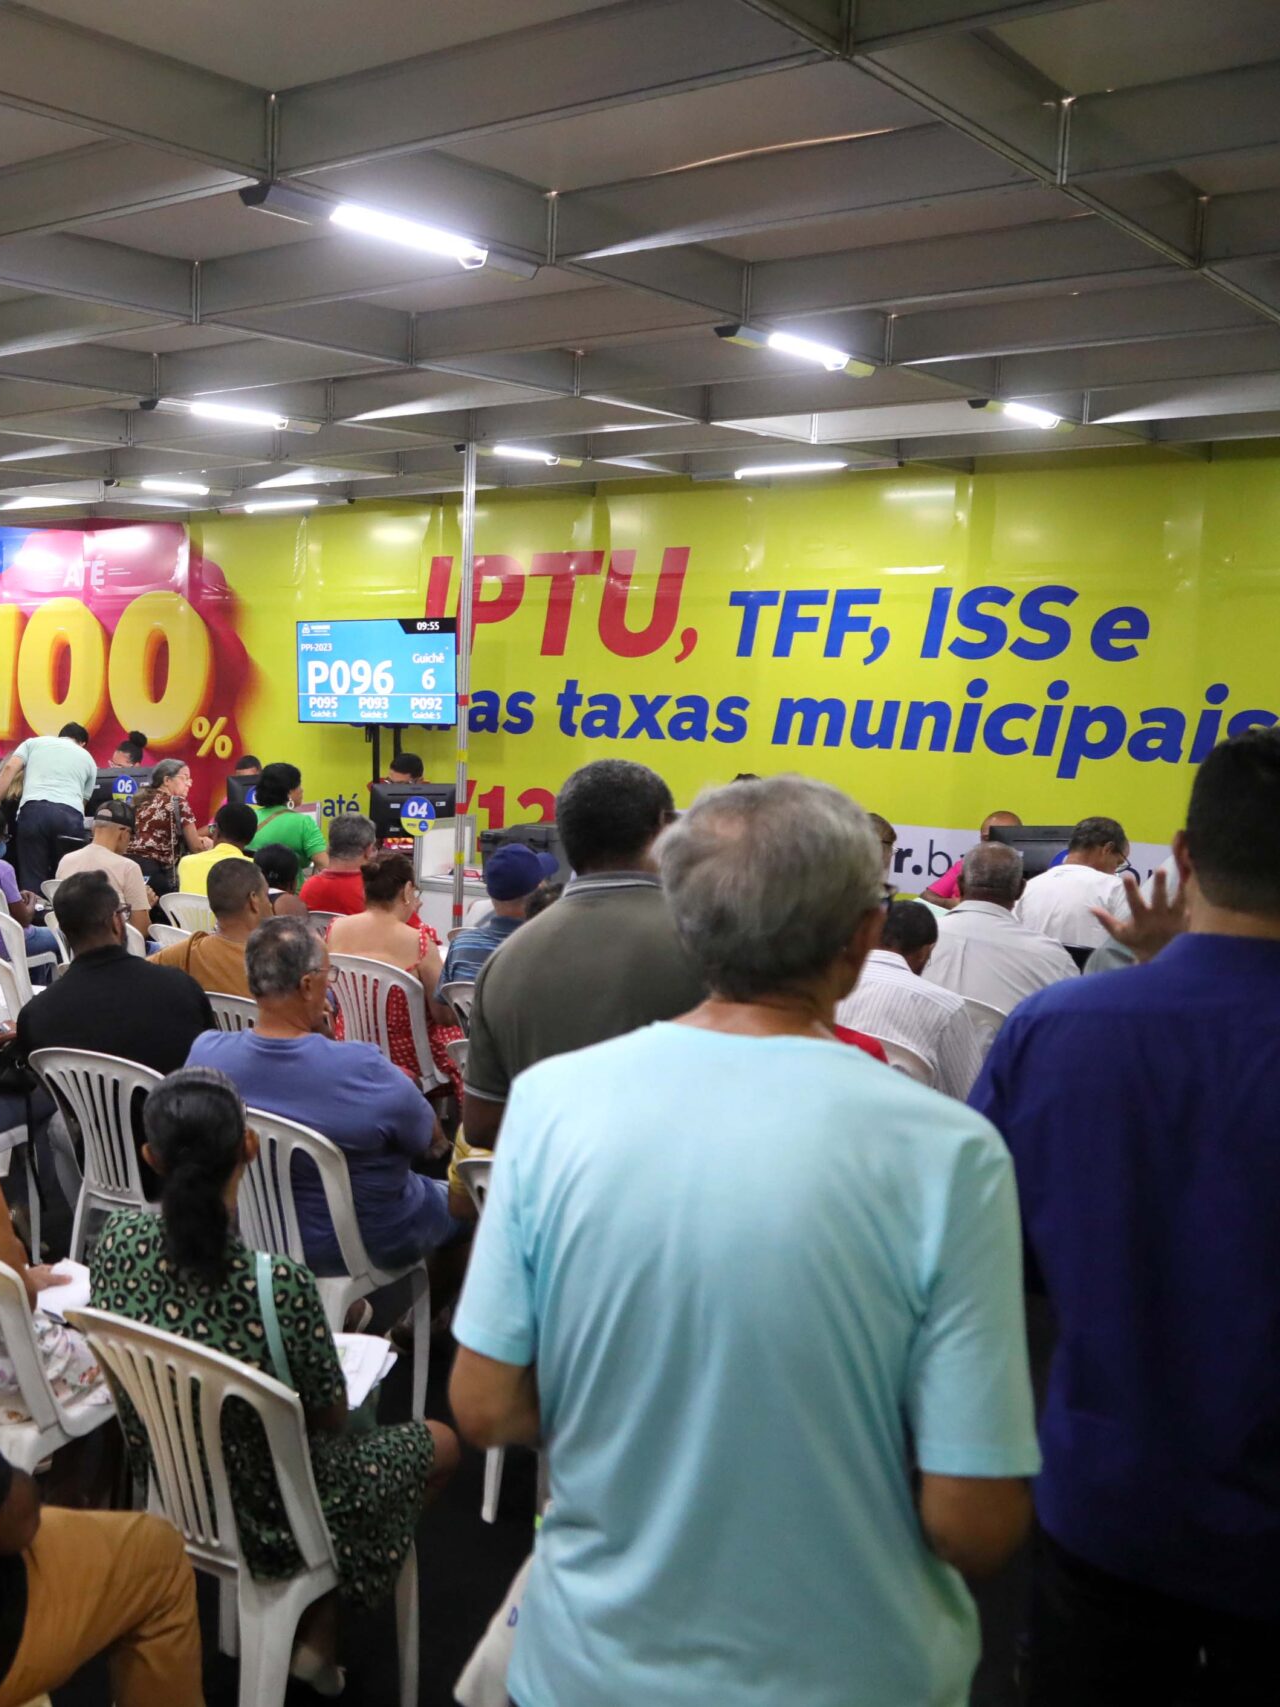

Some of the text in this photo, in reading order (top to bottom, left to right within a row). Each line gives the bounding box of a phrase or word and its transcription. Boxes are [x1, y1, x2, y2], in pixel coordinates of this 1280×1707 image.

[63, 554, 107, 587] ATÉ
[424, 546, 1149, 667] IPTU, TFF, ISS e
[417, 621, 439, 631] 09:55
[412, 653, 445, 664] Guichê
[308, 660, 394, 694] P096
[422, 668, 436, 690] 6
[309, 697, 338, 709] P095
[358, 697, 389, 709] P093
[410, 697, 442, 710] P092
[558, 678, 749, 745] taxas
[118, 779, 132, 793] 06
[323, 793, 360, 817] até
[407, 801, 427, 818] 04
